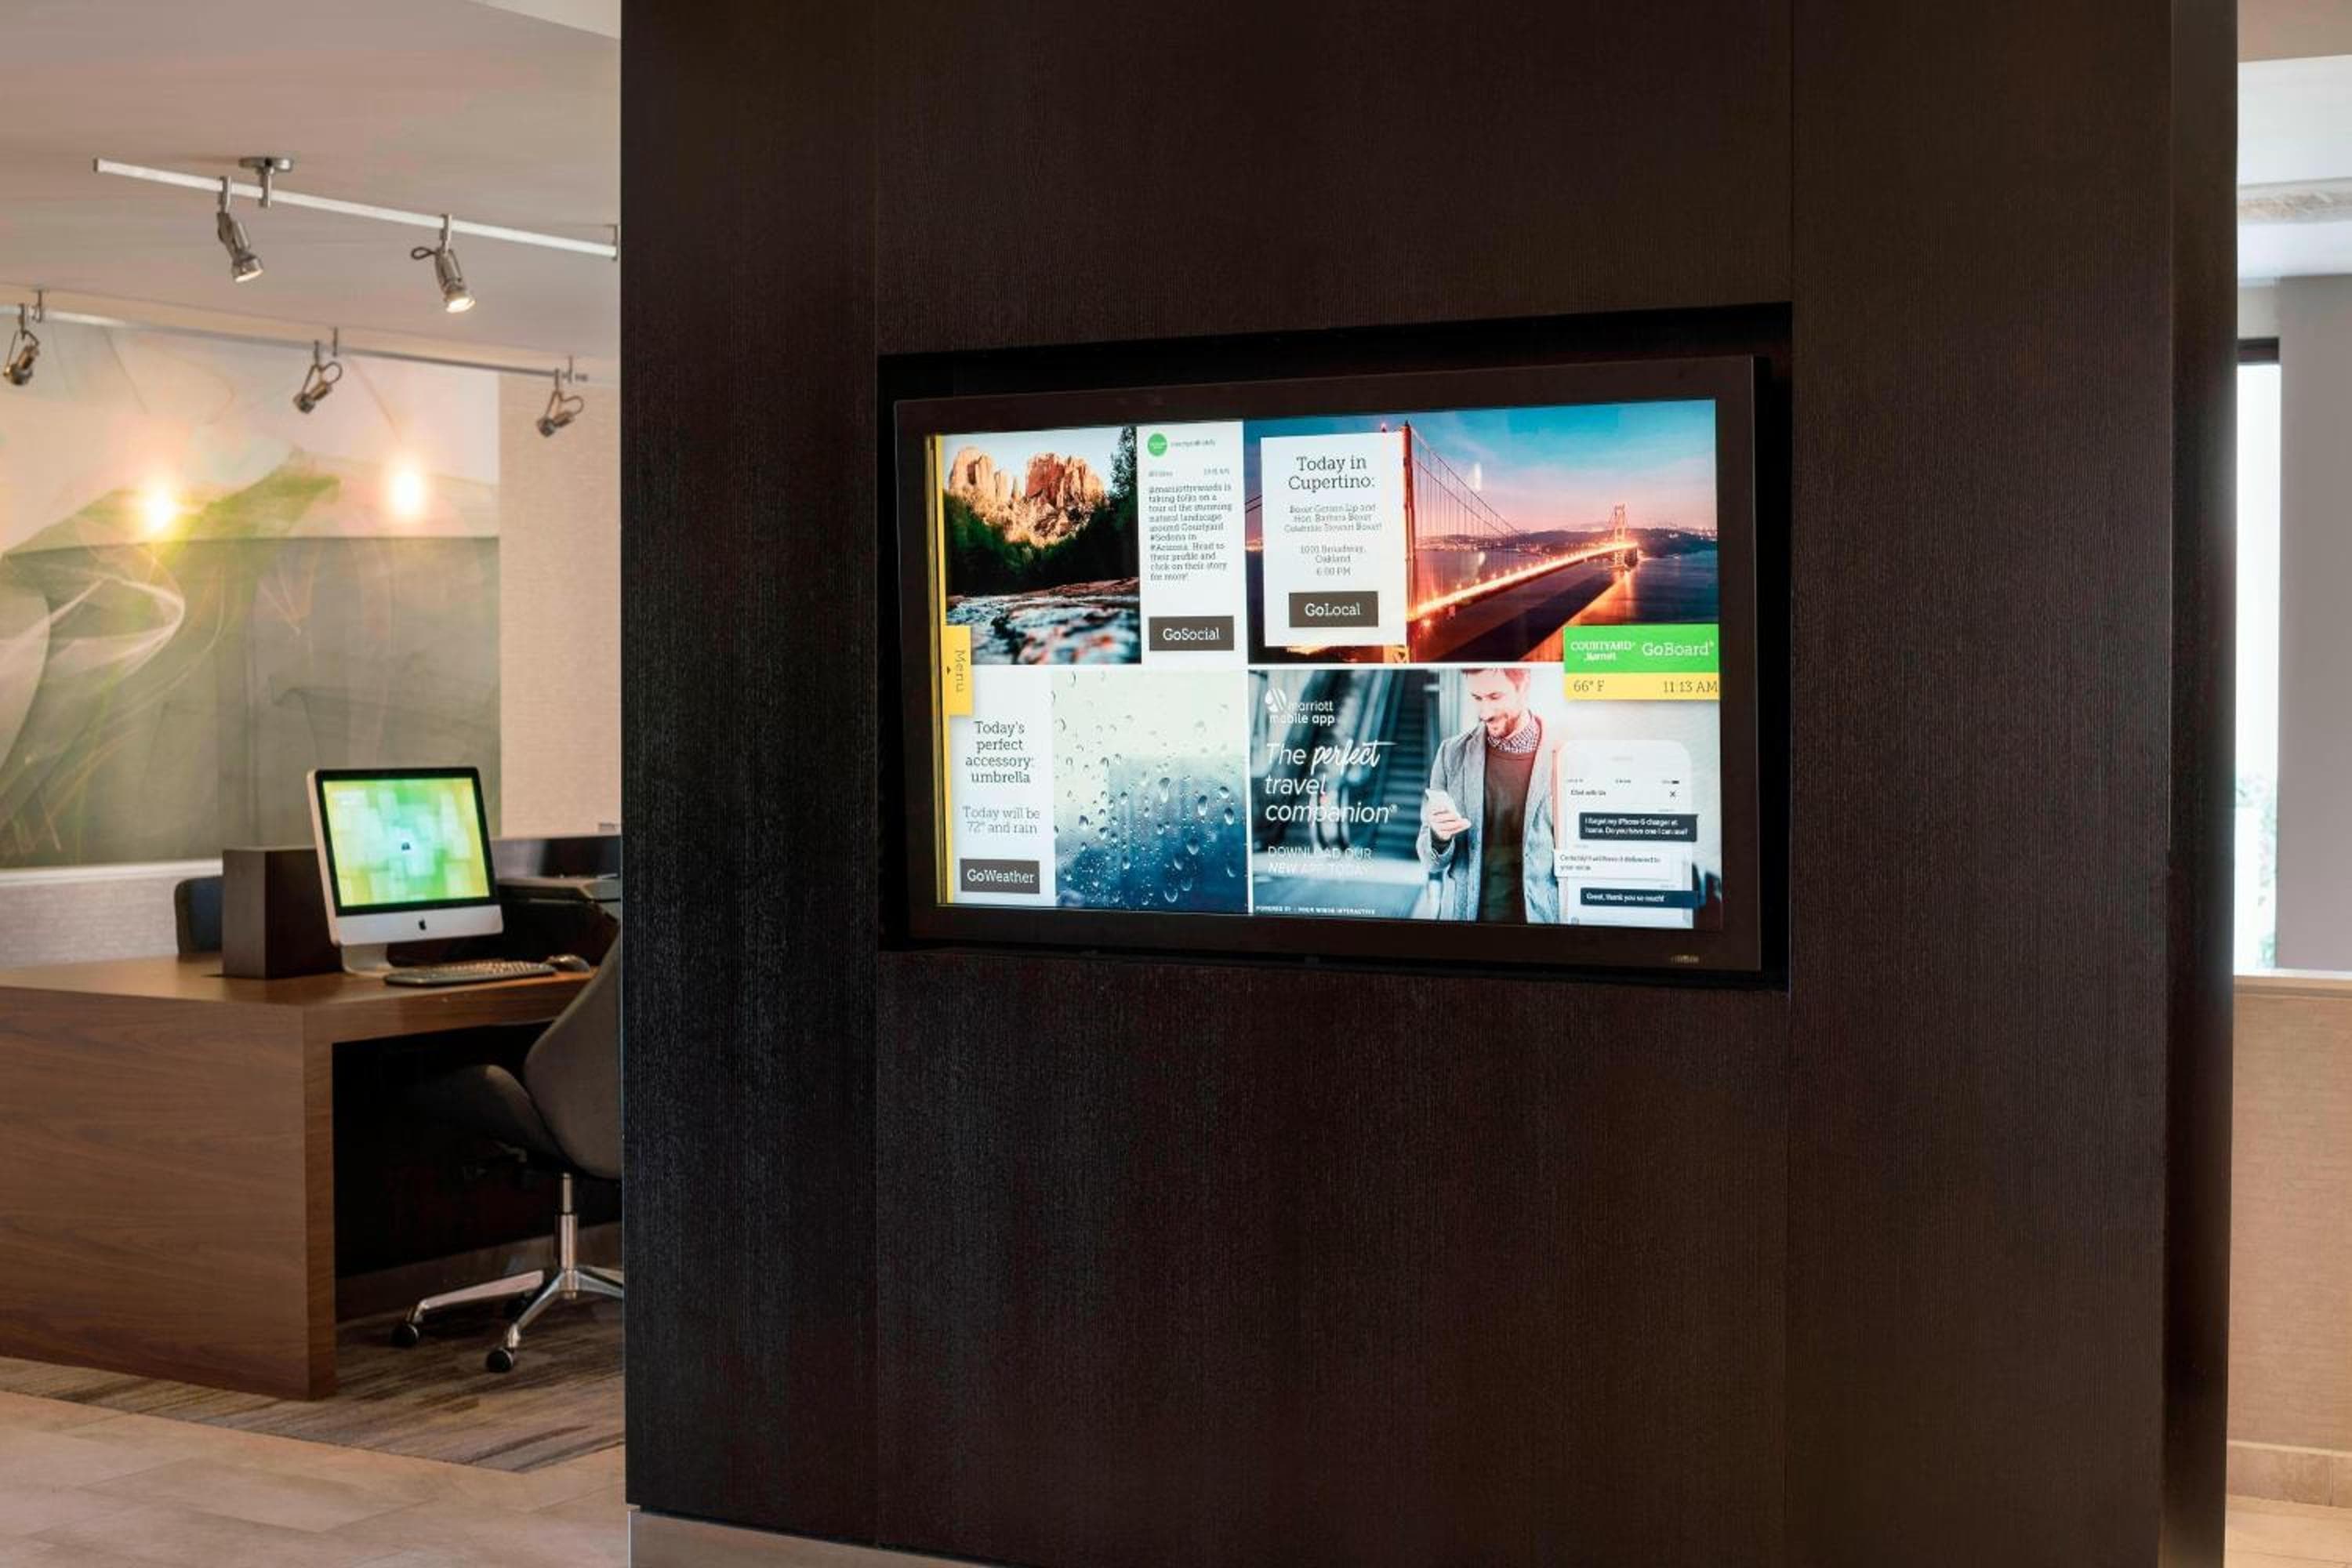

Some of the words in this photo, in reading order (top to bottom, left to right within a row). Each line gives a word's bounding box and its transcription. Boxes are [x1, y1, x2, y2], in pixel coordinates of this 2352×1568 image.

[1296, 456, 1345, 474] Today
[1351, 455, 1367, 470] in
[1288, 475, 1376, 493] Cupertino:
[1149, 495, 1174, 503] taking
[1180, 514, 1222, 523] landscape
[1181, 522, 1224, 532] Courtyard
[1316, 554, 1351, 563] Oakland
[1206, 561, 1228, 571] story
[1337, 566, 1351, 575] PM
[1304, 602, 1361, 617] GoLocal
[1163, 627, 1220, 641] GoSocial
[955, 649, 966, 693] Menu
[1597, 680, 1605, 691] F
[1696, 681, 1718, 693] AM
[1269, 713, 1308, 724] mobile
[1312, 715, 1335, 727] app
[974, 720, 1025, 738] Today's
[976, 738, 1023, 753] perfect
[1266, 742, 1307, 764] The
[1310, 738, 1399, 776] perfect
[971, 771, 1031, 783] umbrella
[1265, 774, 1326, 795] travel
[962, 805, 1000, 820] Today
[1003, 807, 1023, 818] will
[1025, 808, 1040, 819] be
[988, 822, 1011, 833] and
[1014, 823, 1037, 834] rain
[1268, 846, 1342, 860] DOWNLOAD
[1345, 847, 1373, 860] OUR
[1268, 862, 1297, 874] NEW
[966, 868, 1035, 884] GoWeather
